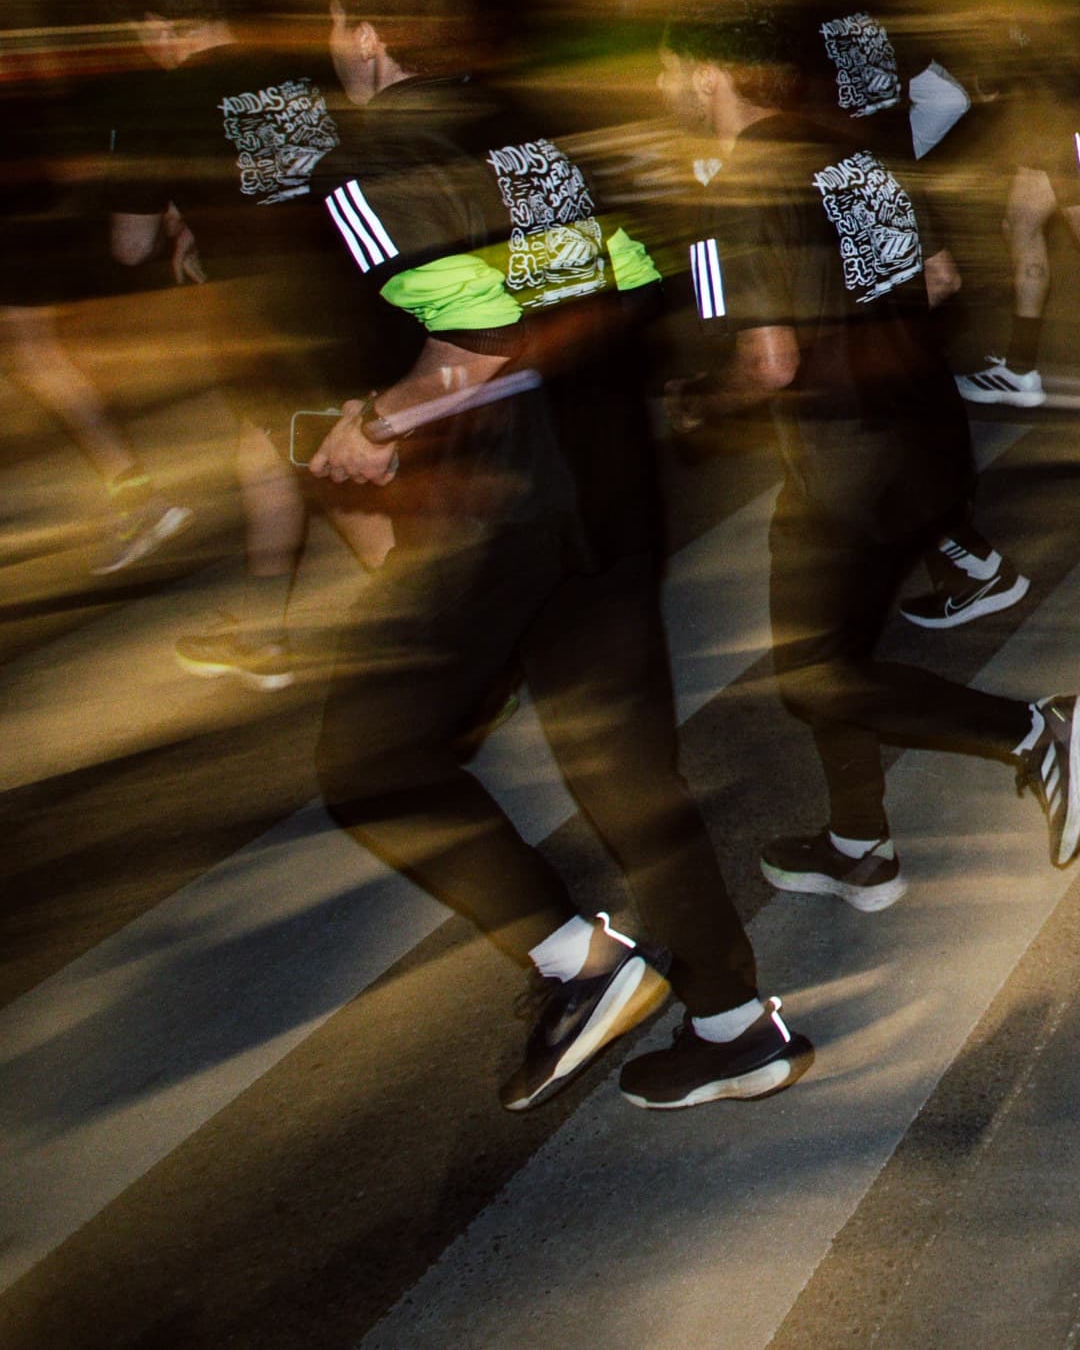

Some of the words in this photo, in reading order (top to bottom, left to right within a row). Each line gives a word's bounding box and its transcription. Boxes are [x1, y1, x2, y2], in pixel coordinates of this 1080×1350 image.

[216, 86, 285, 117] ADIDAS
[486, 142, 549, 176] ADIDAS
[812, 159, 864, 195] ADIDAS
